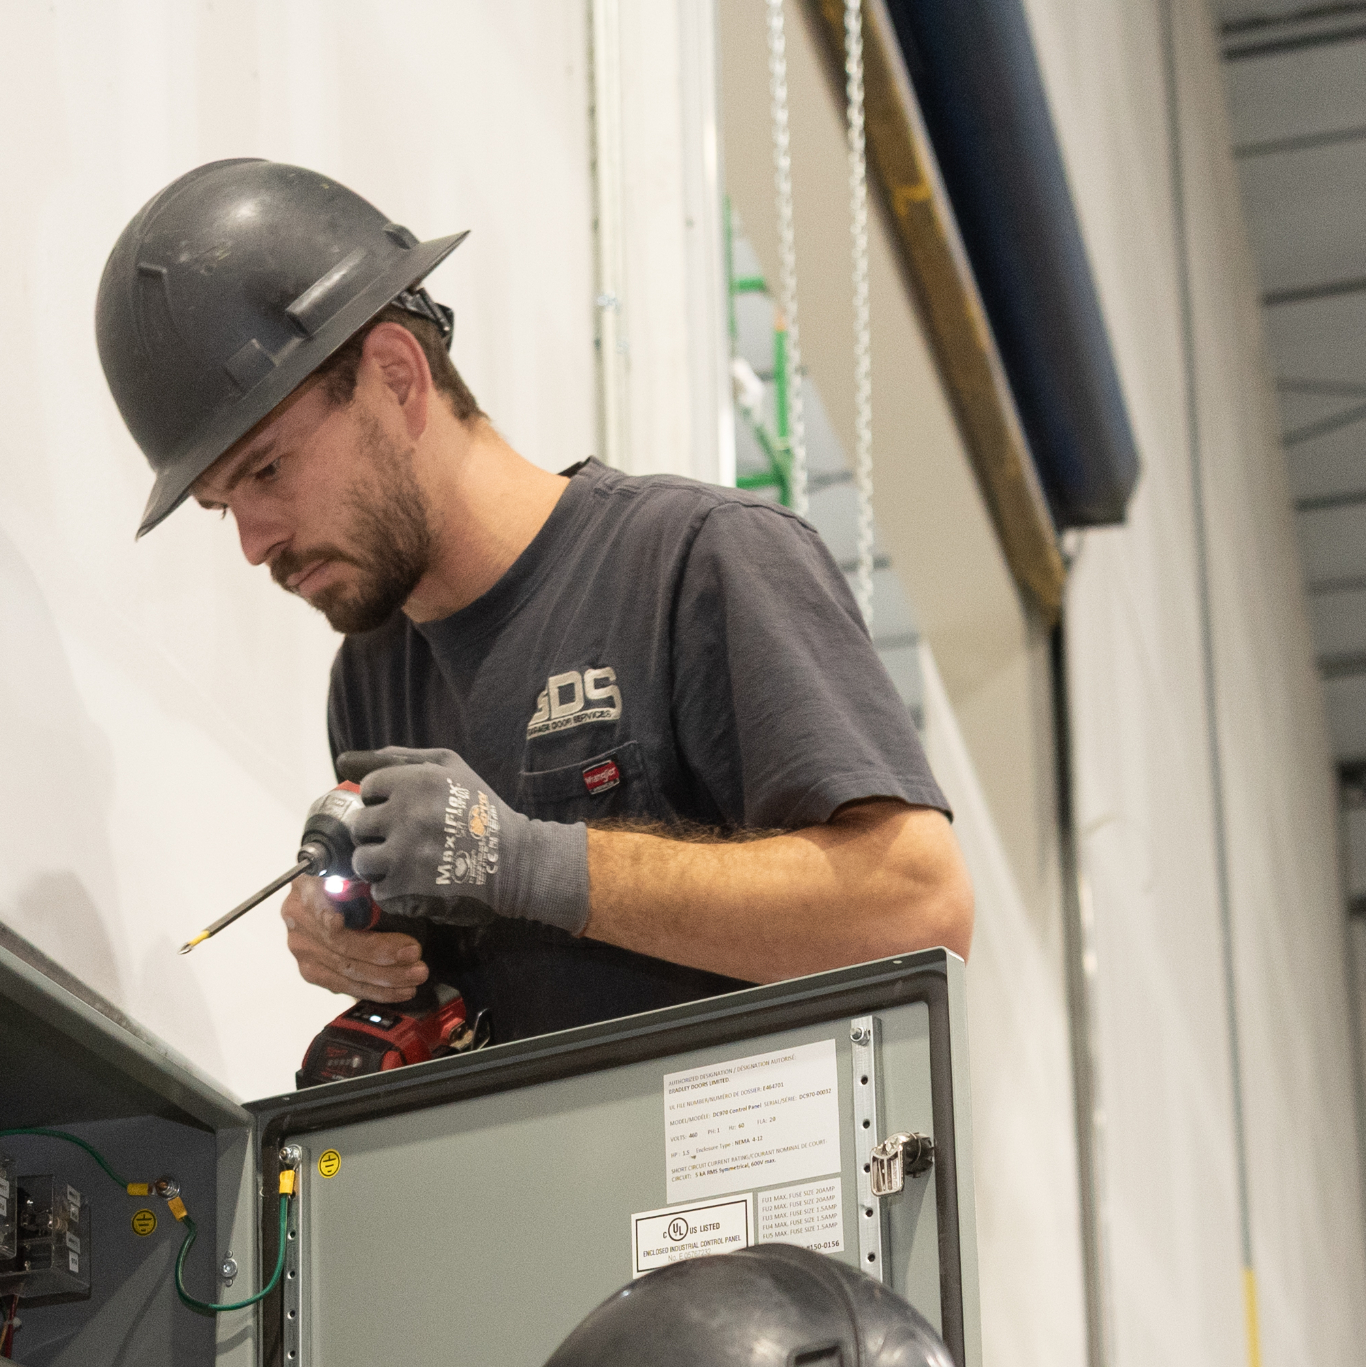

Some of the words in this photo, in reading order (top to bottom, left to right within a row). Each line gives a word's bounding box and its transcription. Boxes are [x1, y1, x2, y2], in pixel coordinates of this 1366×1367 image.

[669, 1074, 699, 1086] AUTHORIZED
[700, 1068, 732, 1081] DESIGNATION
[669, 1085, 690, 1095] BRADLEY
[691, 1081, 708, 1090] DOORS
[712, 1109, 728, 1118] DC970
[729, 1106, 747, 1115] Control
[748, 1102, 761, 1110] Panel
[696, 1144, 718, 1153] Enclosure
[734, 1138, 750, 1146] NEMA
[671, 1166, 687, 1174] SHORT
[688, 1162, 707, 1171] CIRCUIT
[707, 1158, 730, 1167] CURRENT
[775, 1144, 799, 1154] NOMINAL
[671, 1173, 691, 1182] CIRCUIT:
[707, 1168, 718, 1176] RMS
[719, 1163, 750, 1174] Symmetrical,
[762, 1196, 772, 1204] FU1
[773, 1194, 788, 1202] MAX.
[789, 1191, 802, 1199] FUSE
[815, 1186, 835, 1194] 20AMP
[773, 1203, 788, 1211] MAX.
[789, 1200, 802, 1208] FUSE
[815, 1195, 835, 1204] 20AMP
[789, 1209, 802, 1217] FUSE
[816, 1203, 837, 1213] 1.5AMP
[789, 1218, 802, 1226] FUSE
[816, 1212, 837, 1221] 1.5AMP
[689, 1226, 698, 1234] US
[699, 1222, 720, 1232] LISTED
[790, 1227, 803, 1235] FUSE
[817, 1222, 838, 1231] 1.5AMP
[643, 1246, 669, 1258] ENCLOSED
[669, 1241, 699, 1253] INDUSTRIAL
[700, 1237, 724, 1248] CONTROL
[724, 1234, 741, 1243] PANEL
